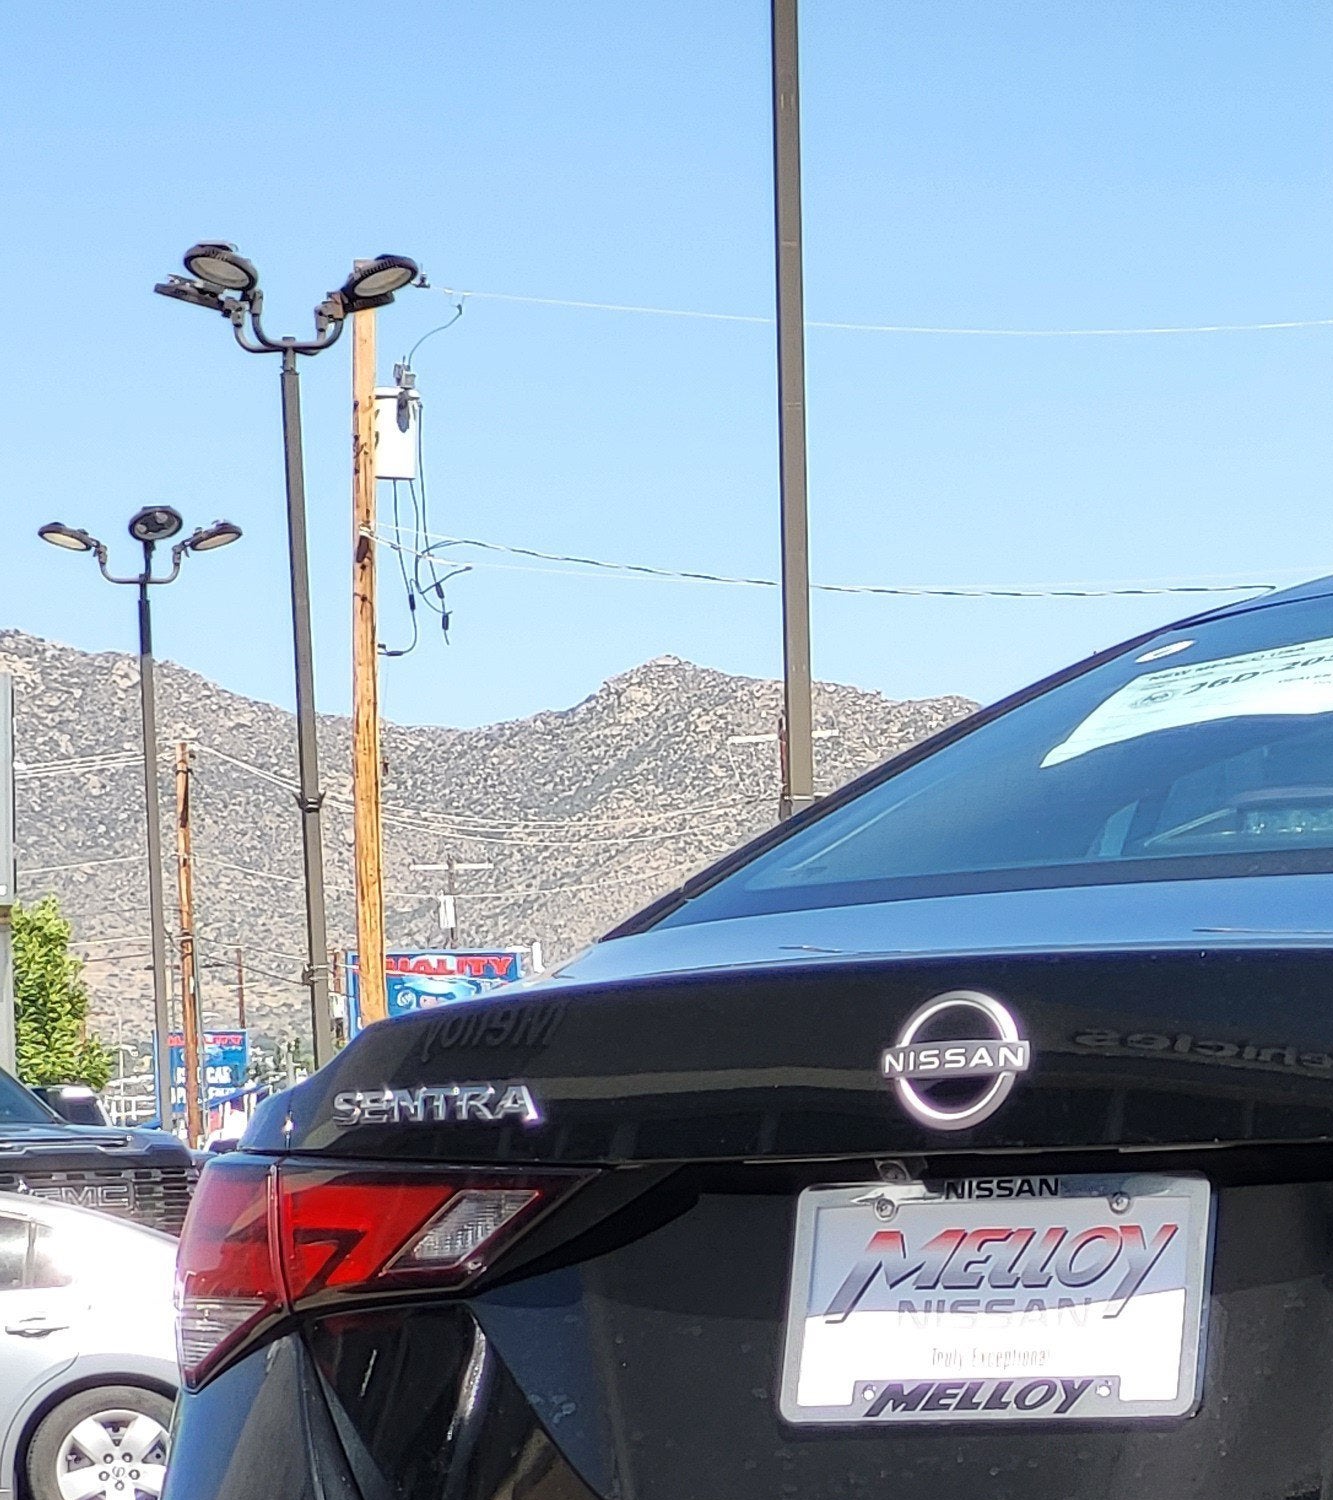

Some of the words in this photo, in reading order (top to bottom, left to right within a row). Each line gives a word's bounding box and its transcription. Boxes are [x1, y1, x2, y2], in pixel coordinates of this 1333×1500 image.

[353, 956, 513, 976] UALITY
[884, 1047, 1024, 1074] NISSAN
[333, 1085, 542, 1126] SENTRA
[944, 1178, 1060, 1199] NISSAN
[824, 1224, 1180, 1323] MELLOY
[898, 1298, 1091, 1328] NISSAN
[863, 1380, 1092, 1417] MELLOY
